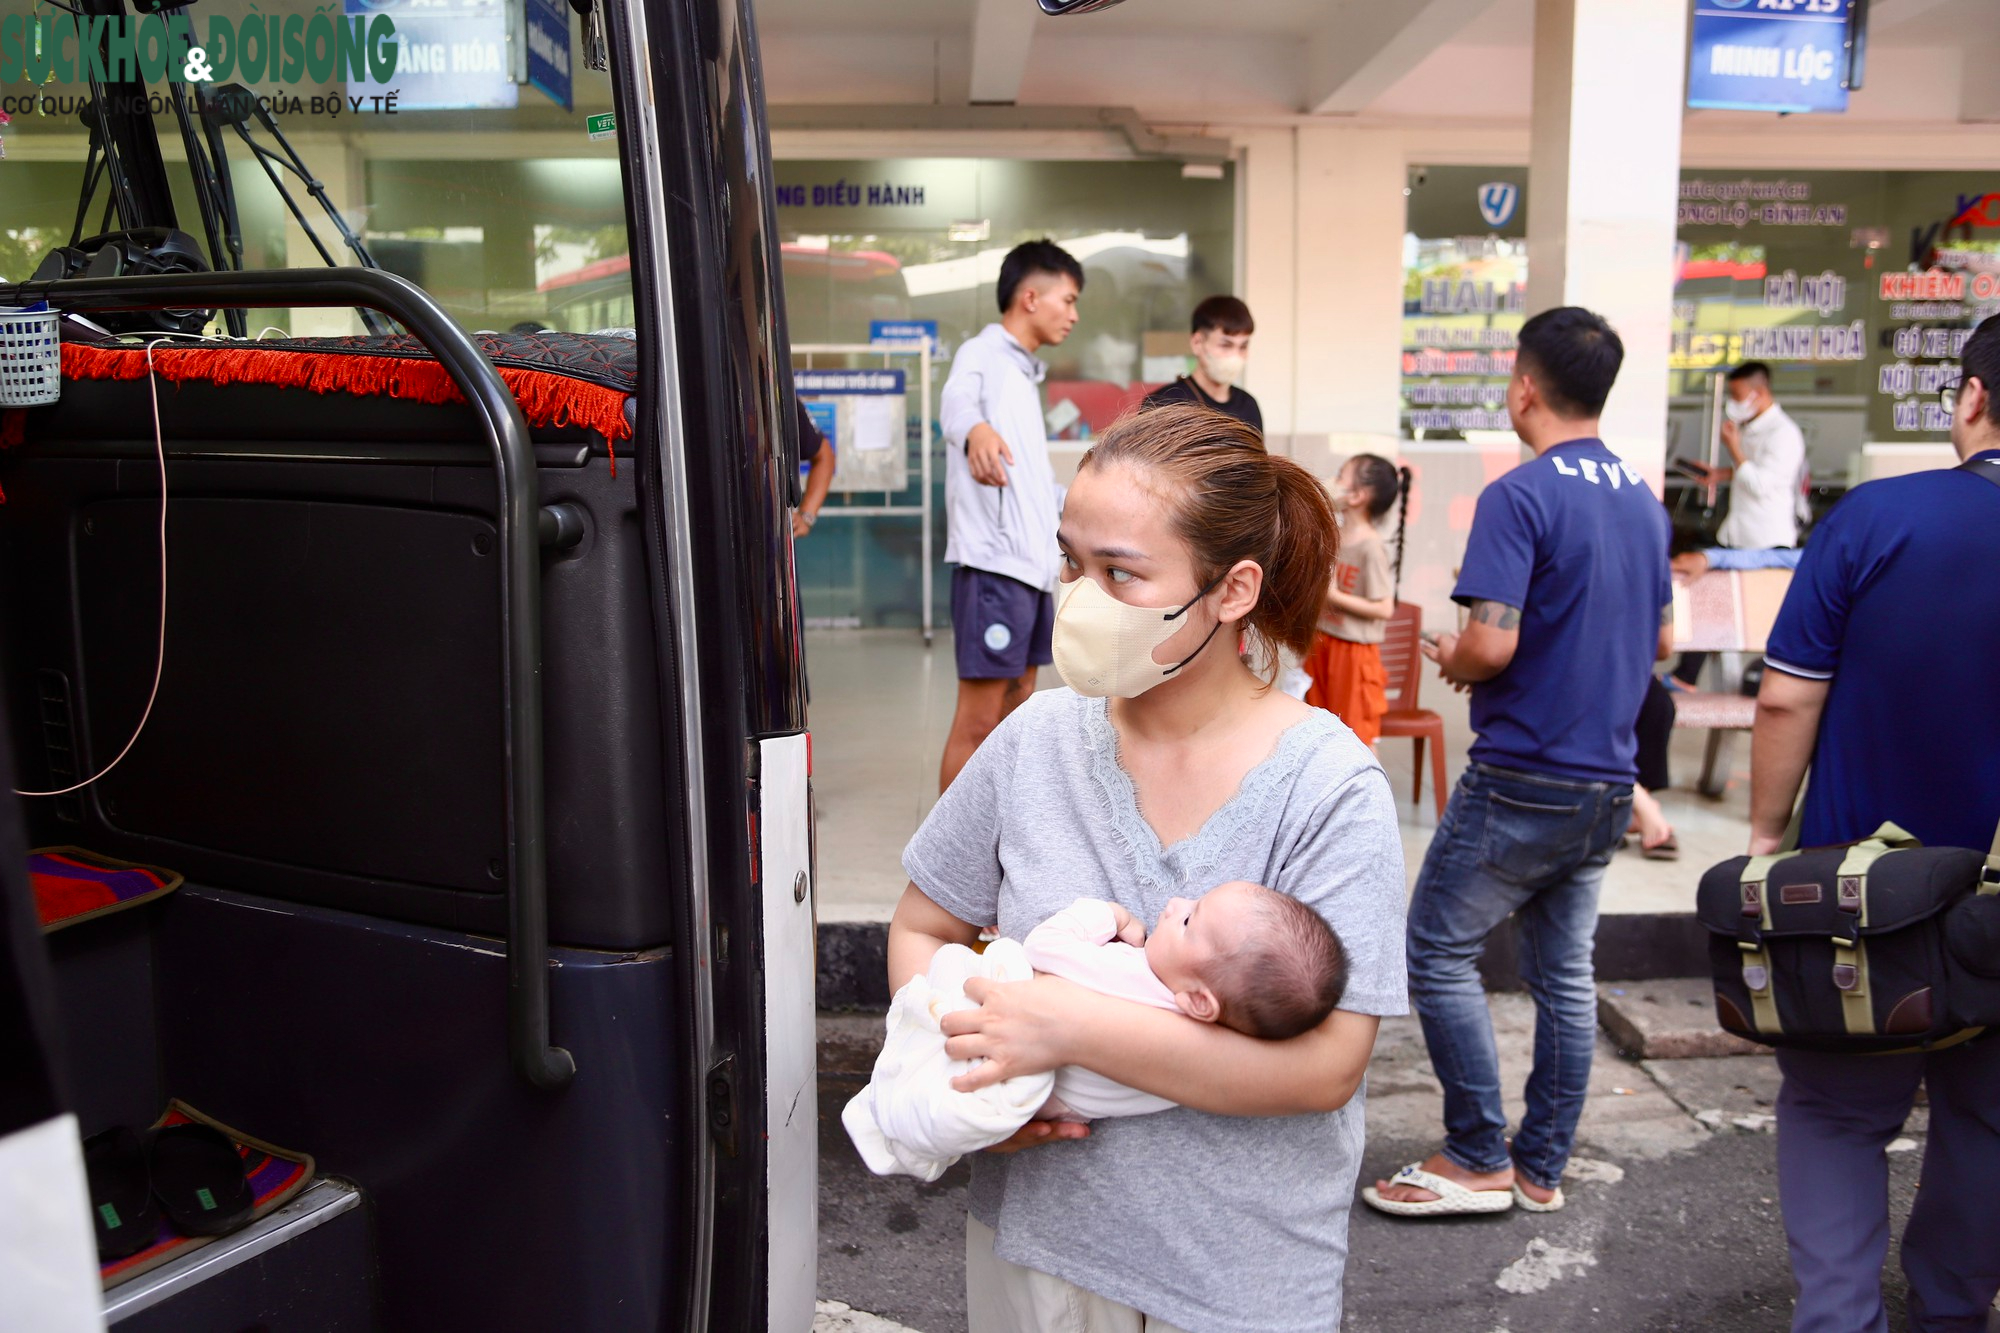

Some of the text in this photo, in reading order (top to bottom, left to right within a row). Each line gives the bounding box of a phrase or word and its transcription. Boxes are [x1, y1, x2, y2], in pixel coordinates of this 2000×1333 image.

[1710, 43, 1834, 85] MINH LỘC
[776, 185, 806, 207] NG
[867, 181, 924, 206] HÀNH
[1764, 269, 1846, 317] HÀ NỘI
[1880, 265, 1965, 300] KHIÊM
[1740, 319, 1866, 360] THANH HOÁ
[1893, 323, 1922, 358] CÓ
[1922, 328, 1950, 358] XE
[1879, 360, 1913, 399] NỘI
